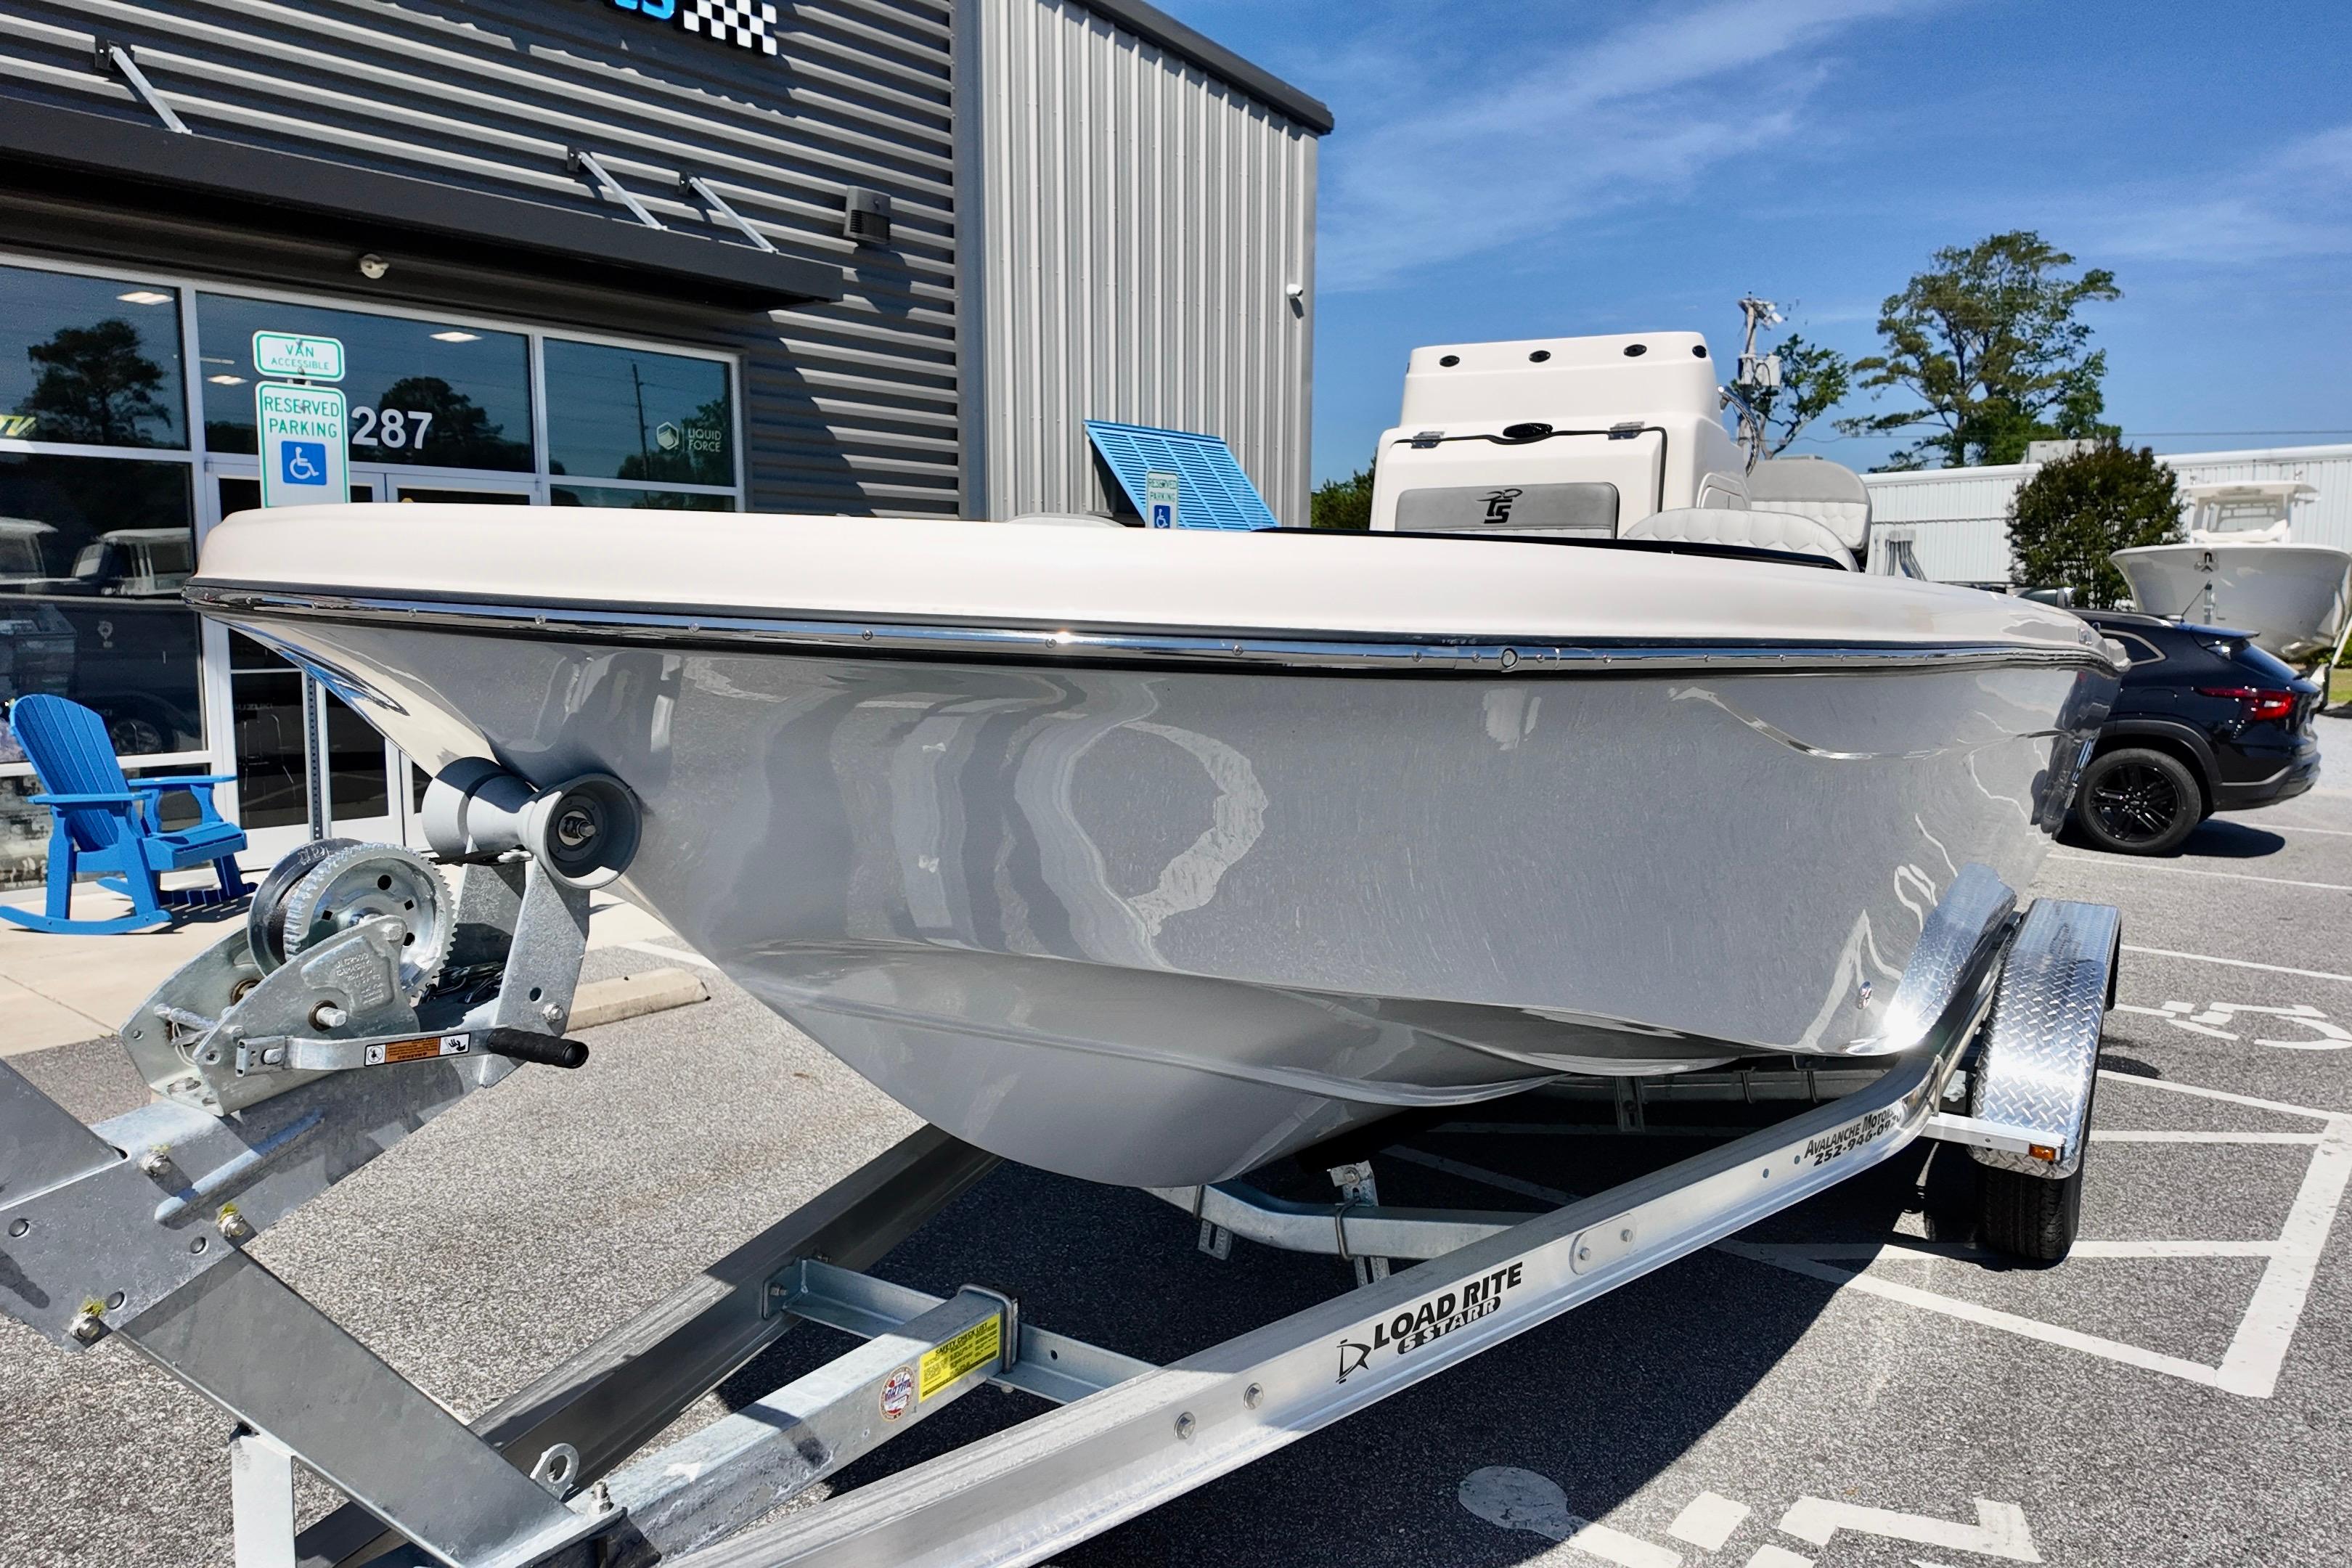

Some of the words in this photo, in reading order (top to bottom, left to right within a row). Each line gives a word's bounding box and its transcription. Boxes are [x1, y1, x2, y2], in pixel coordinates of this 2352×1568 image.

[285, 344, 314, 357] VAN
[271, 358, 330, 370] ACCESSIBLE
[264, 396, 340, 417] RESERVED
[269, 418, 338, 438] PARKING
[351, 406, 433, 449] 287
[688, 428, 722, 441] LIQUID
[688, 441, 721, 452] FORCE
[1148, 478, 1177, 489] RESERVED
[1150, 491, 1175, 502] PARKING
[1804, 1123, 1861, 1159] AVALANCHE
[1373, 1292, 1456, 1349] LOAD
[1463, 1261, 1523, 1309] RITE
[936, 1339, 957, 1355] SAFETY
